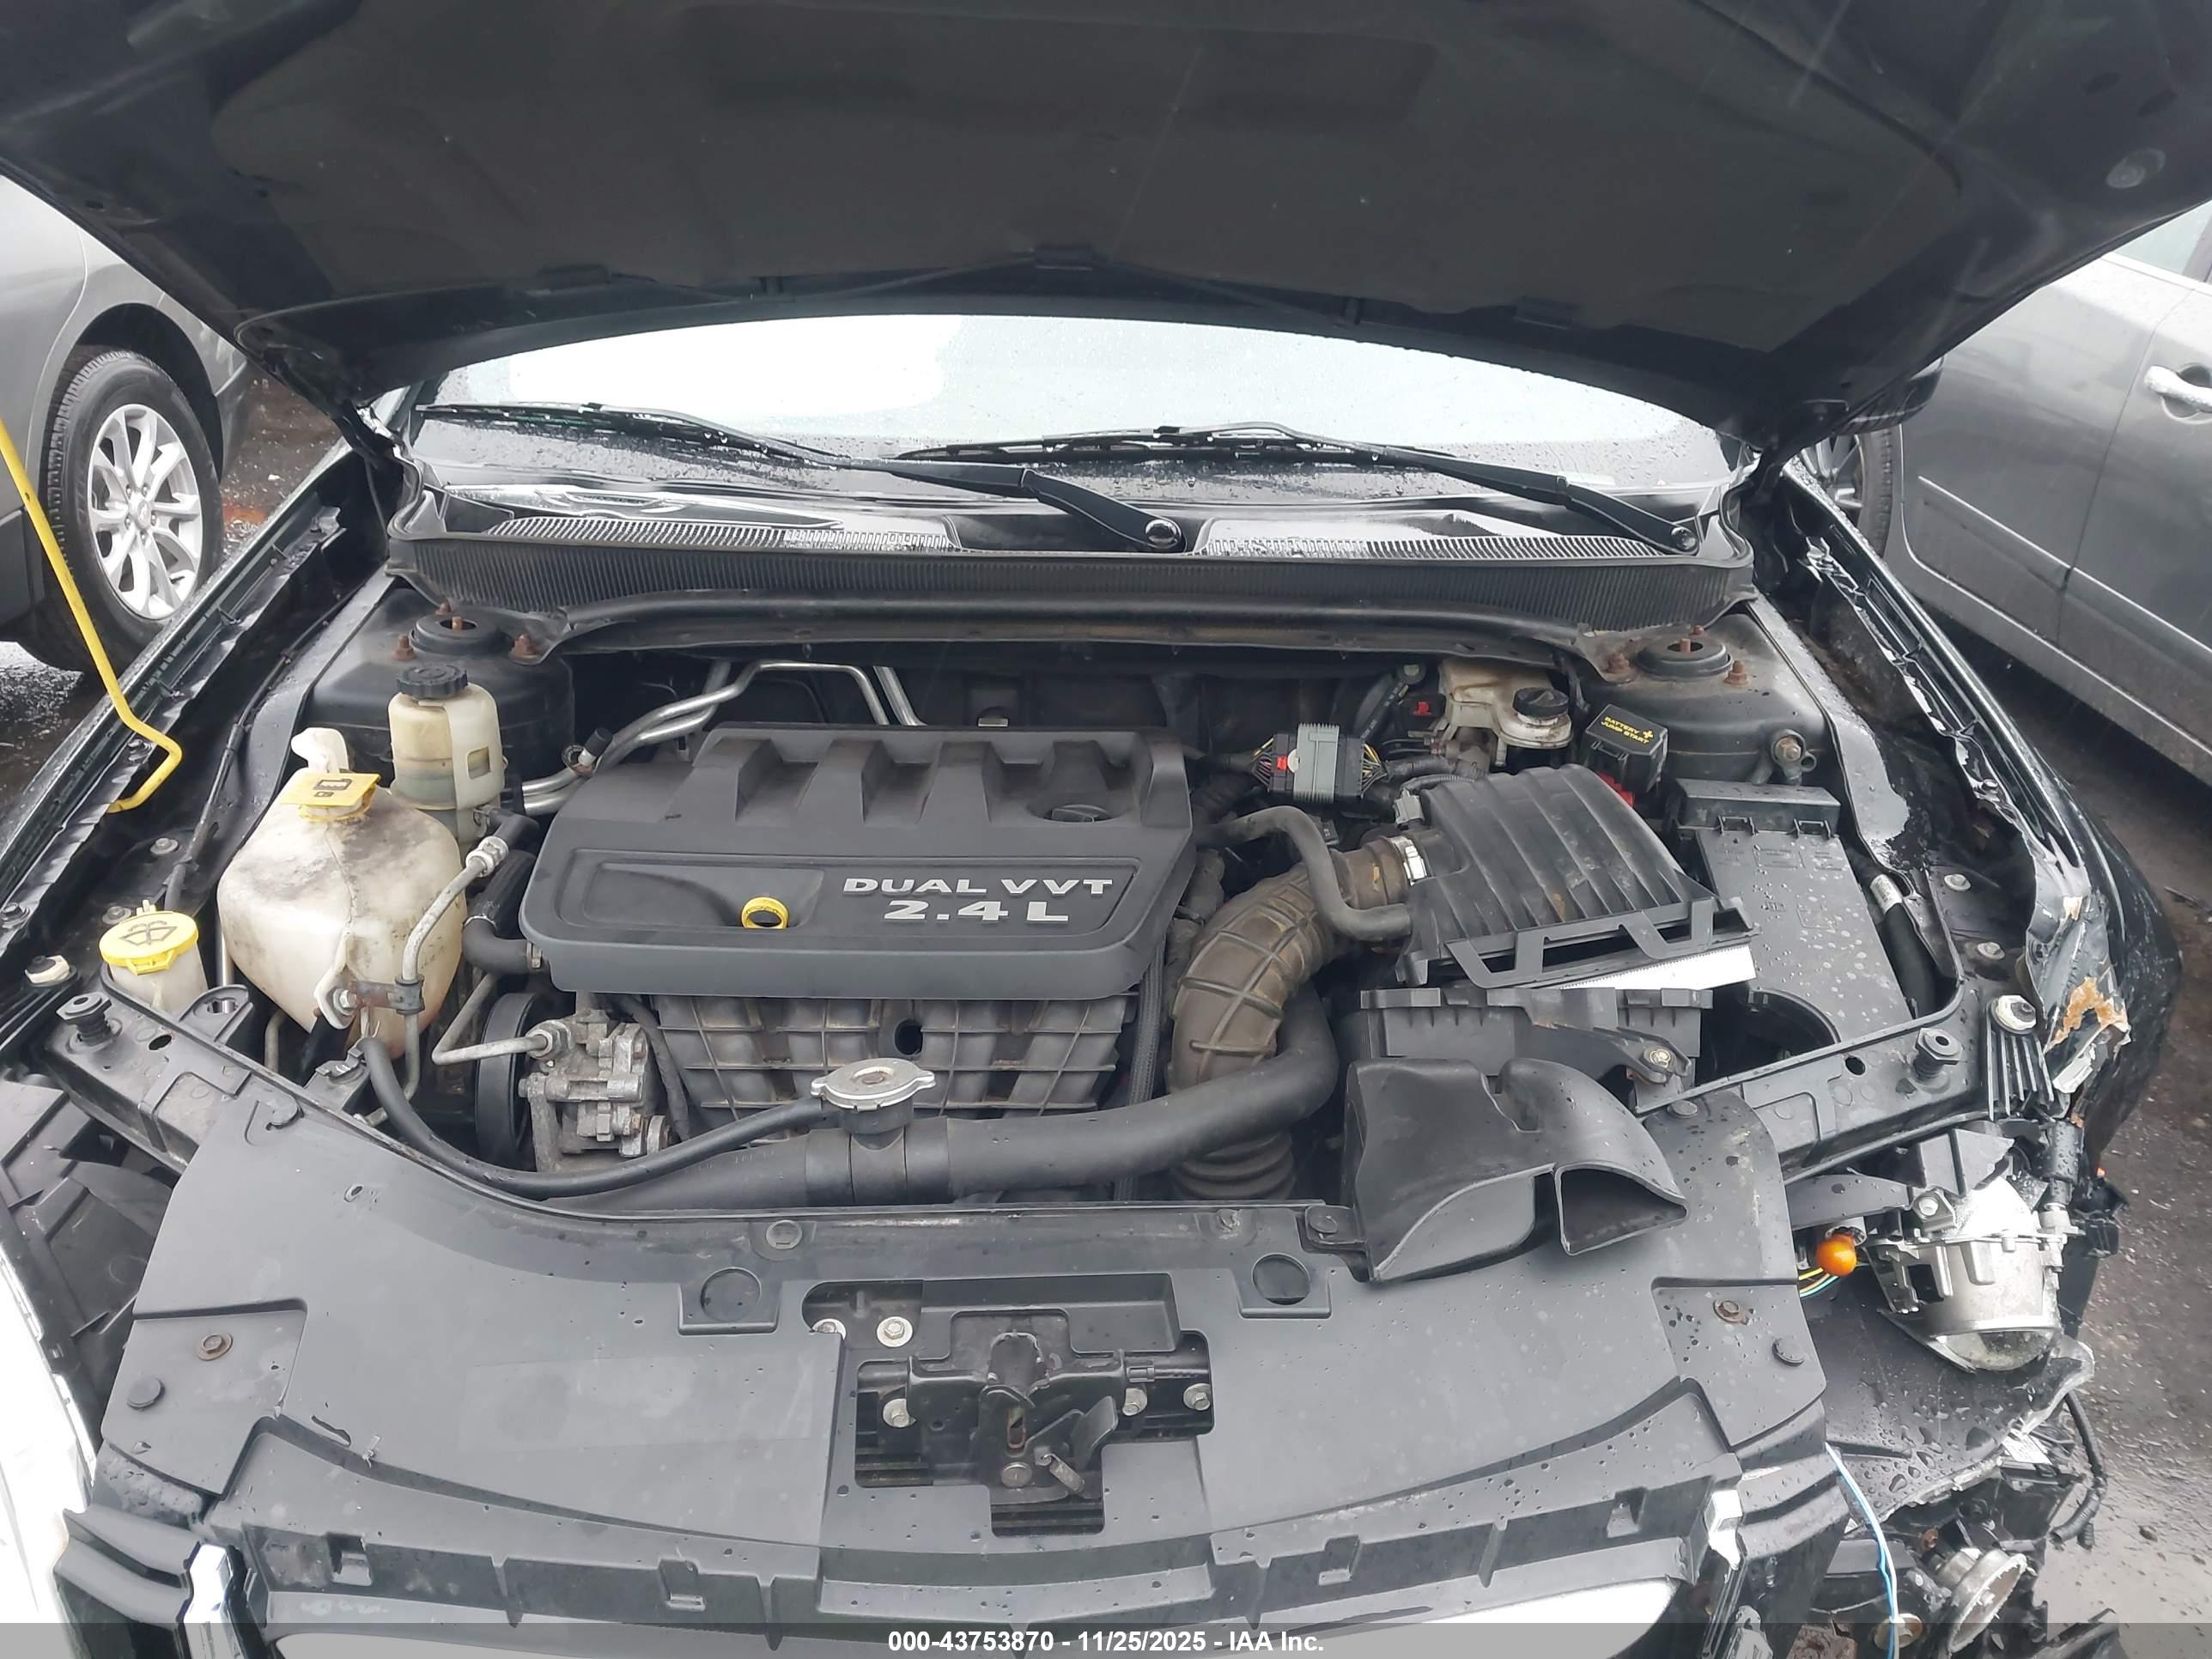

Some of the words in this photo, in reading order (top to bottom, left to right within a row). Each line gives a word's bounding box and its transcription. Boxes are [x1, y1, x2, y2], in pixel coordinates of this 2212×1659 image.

[1601, 720, 1623, 732] JUMP
[1623, 731, 1650, 744] START
[1604, 716, 1640, 734] BATTERY
[843, 878, 987, 894] DUAL
[1000, 878, 1113, 895] VVT
